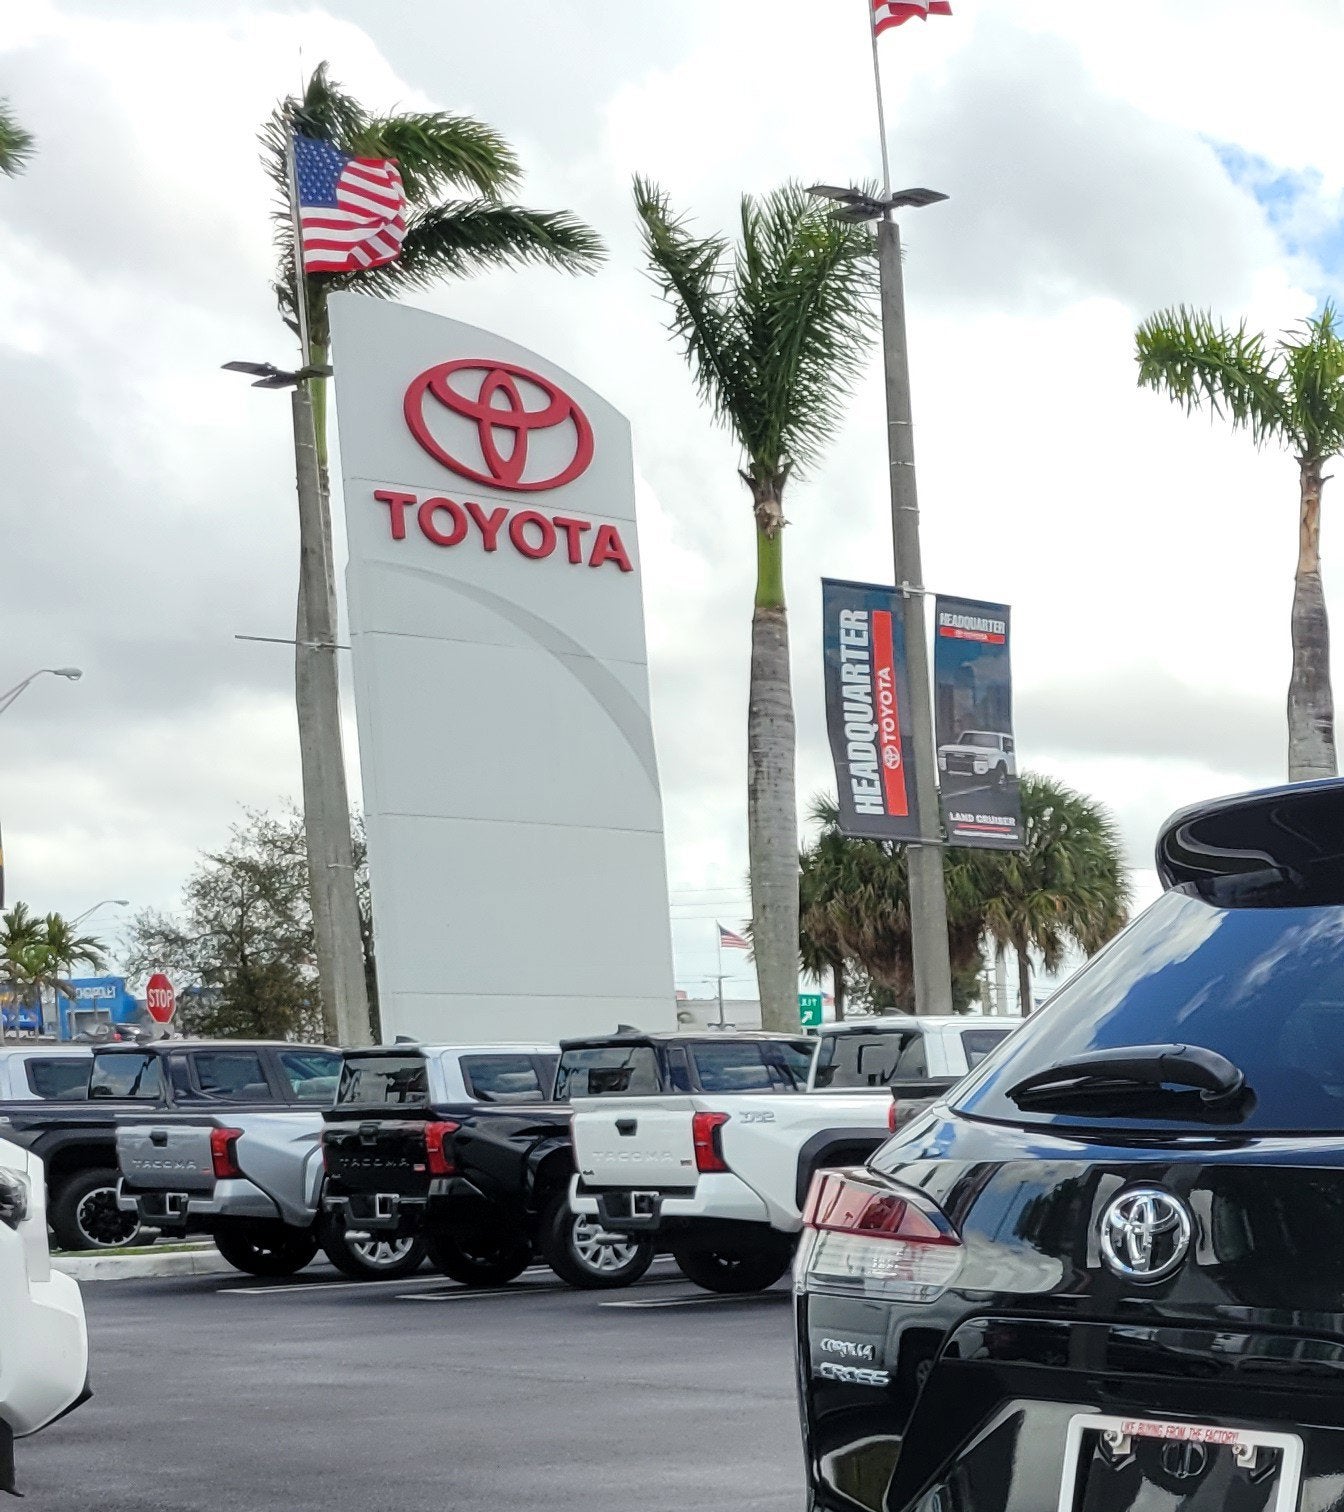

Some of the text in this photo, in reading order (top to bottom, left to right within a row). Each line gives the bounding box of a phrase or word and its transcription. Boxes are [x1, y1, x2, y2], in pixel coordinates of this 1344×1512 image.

[373, 489, 634, 572] TOYOTA
[840, 608, 885, 815] HEADQUARTER
[875, 666, 899, 745] TOYOTA
[949, 811, 975, 823] LAND
[149, 988, 174, 1008] STOP
[132, 1159, 197, 1170] TACOMA
[592, 1150, 675, 1163] TACOMA
[820, 1362, 890, 1386] CROSS
